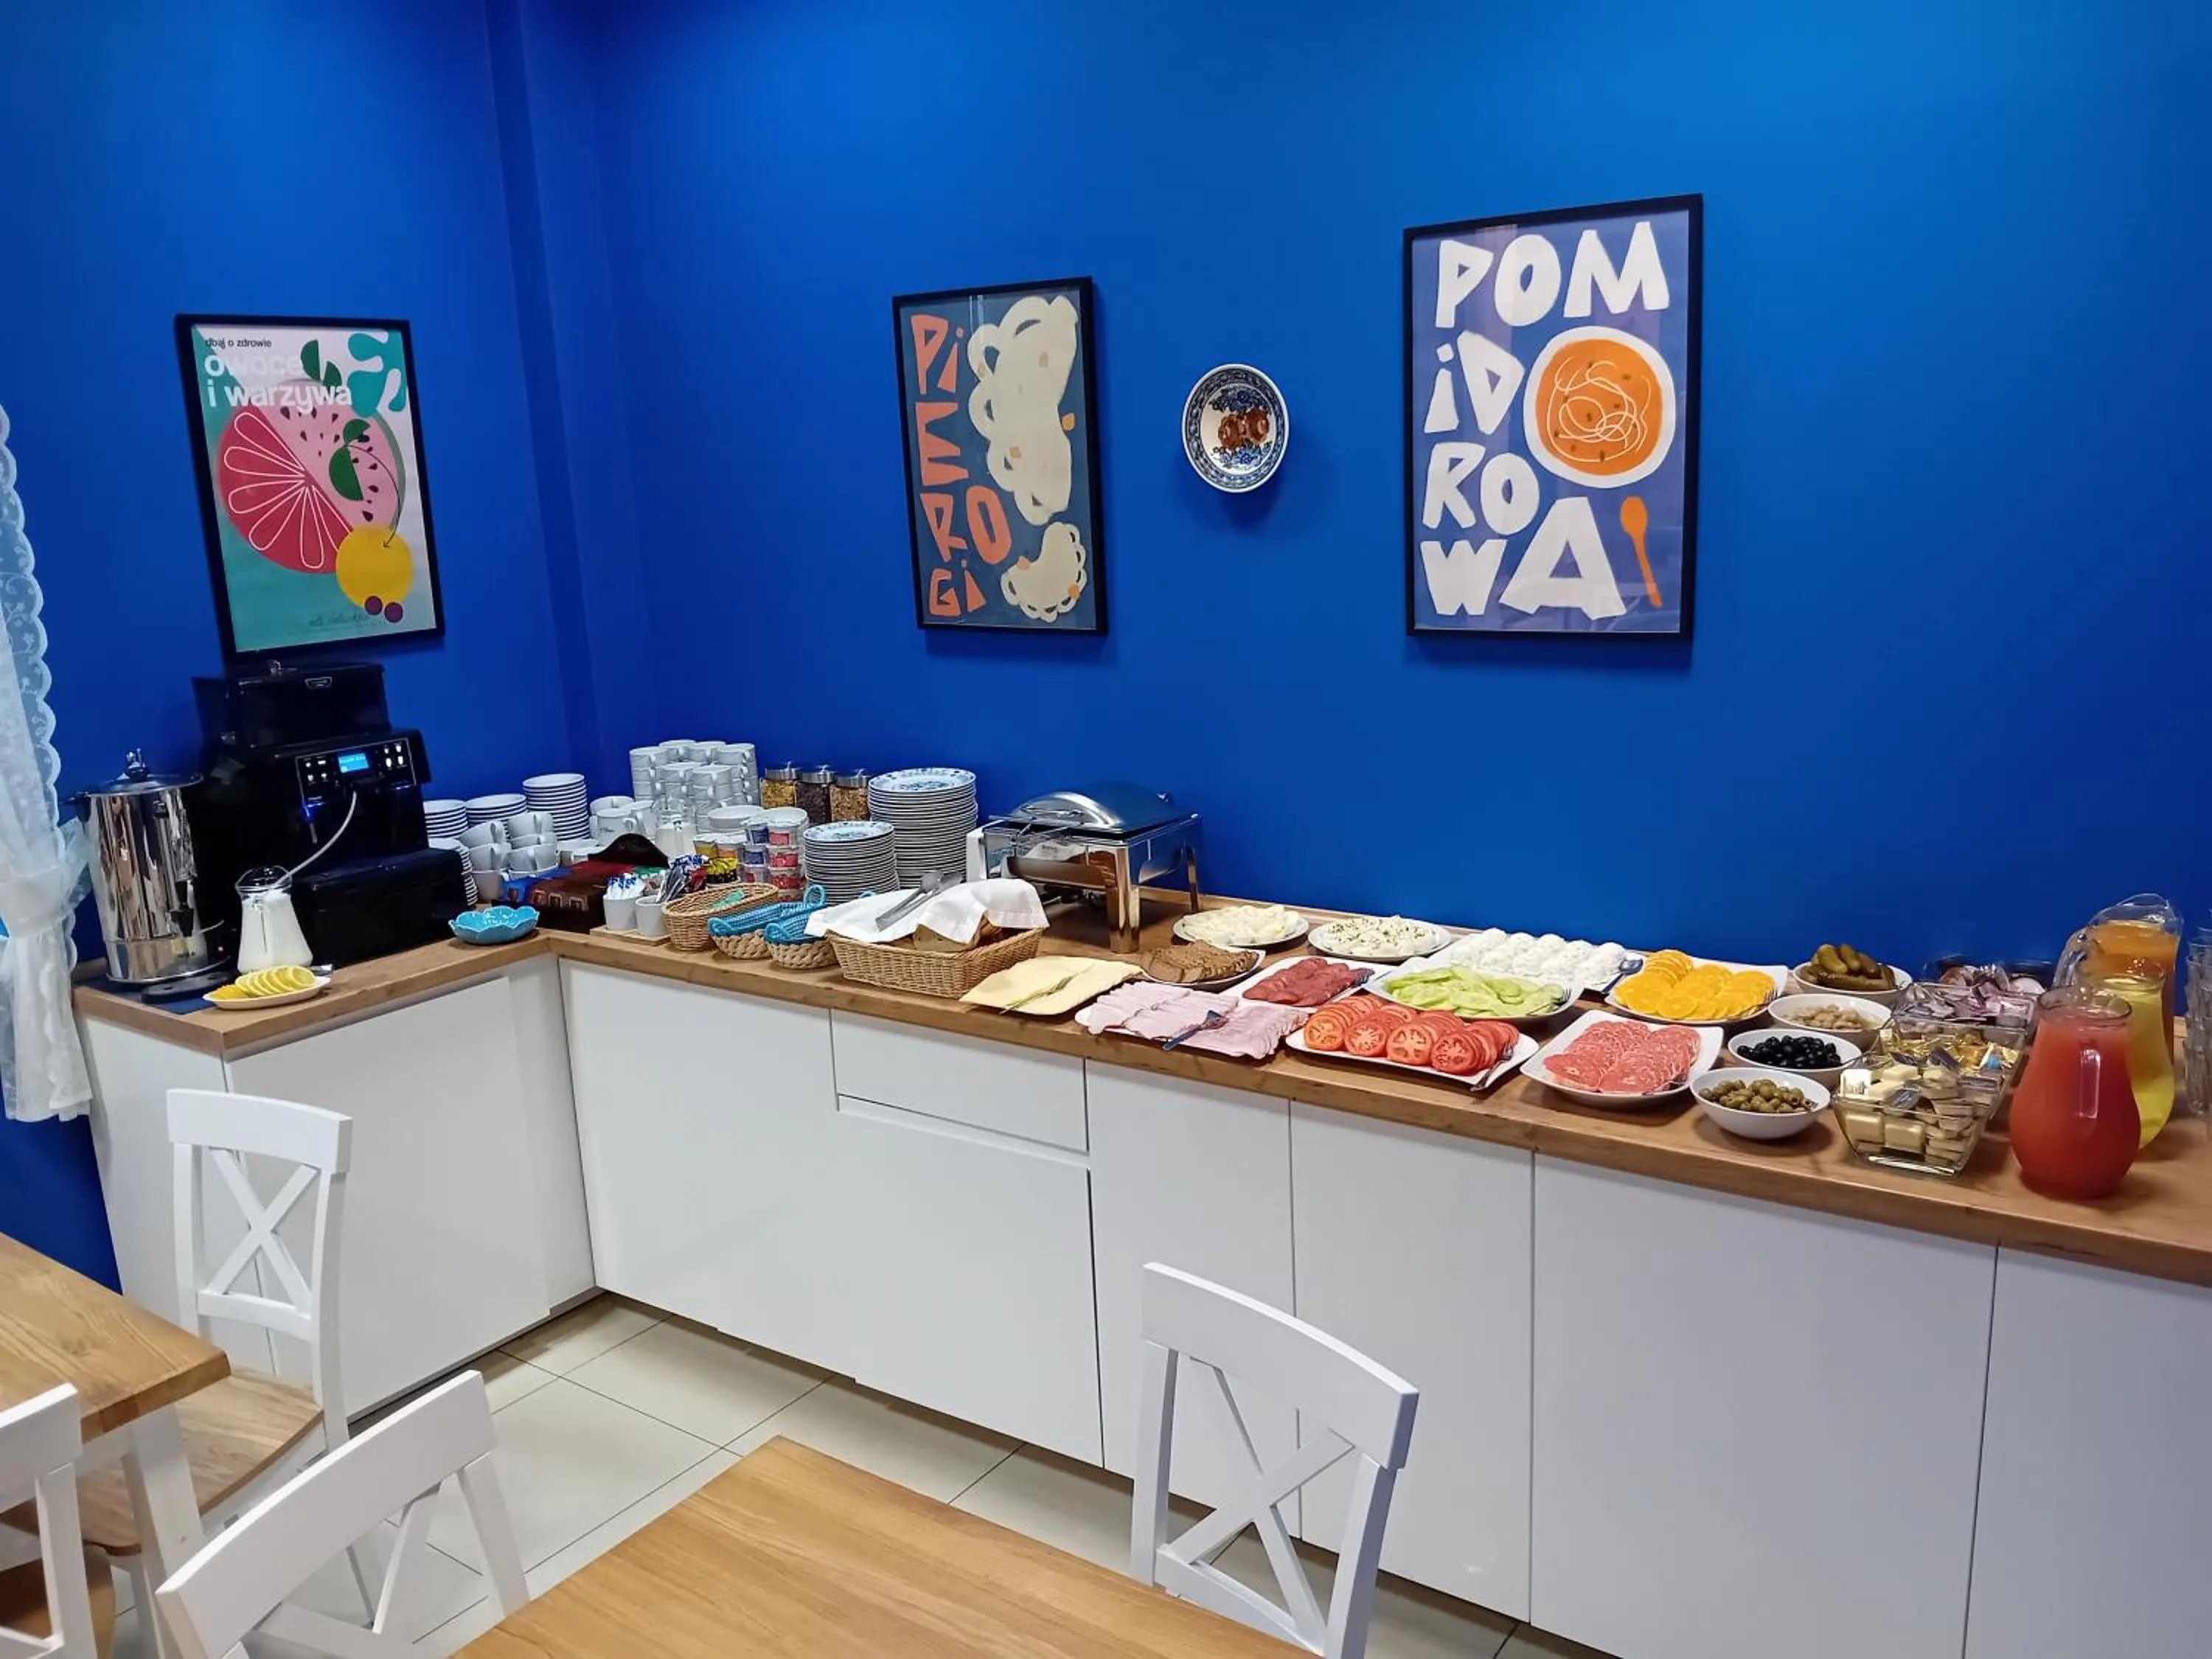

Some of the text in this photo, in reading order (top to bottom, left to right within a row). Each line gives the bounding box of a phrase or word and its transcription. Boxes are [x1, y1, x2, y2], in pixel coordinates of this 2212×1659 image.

[1435, 221, 1669, 327] POM
[237, 338, 271, 347] zdrowie
[207, 379, 352, 414] i warzywa
[1423, 442, 1540, 535] RO
[1420, 496, 1627, 620] WA
